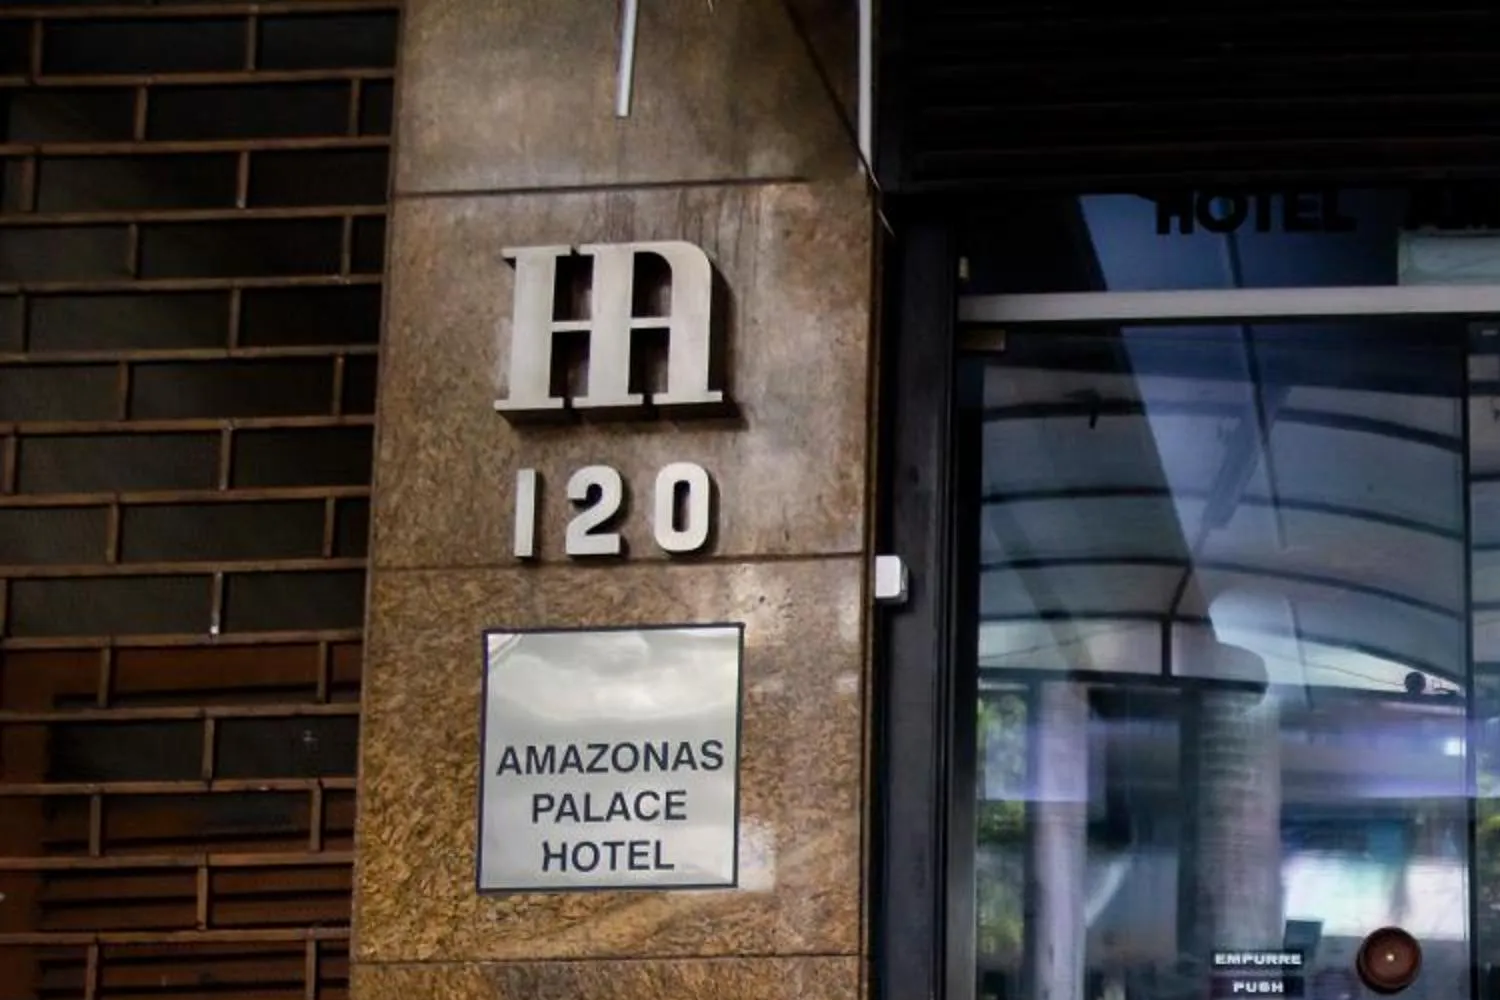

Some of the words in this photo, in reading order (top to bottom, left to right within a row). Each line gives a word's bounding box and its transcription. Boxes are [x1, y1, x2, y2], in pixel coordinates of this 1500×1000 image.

[1157, 187, 1357, 234] HOTEL
[514, 462, 711, 557] 120
[496, 739, 724, 777] AMAZONAS
[532, 789, 688, 824] PALACE
[541, 840, 675, 872] HOTEL
[1214, 952, 1302, 965] EMPURRE
[1233, 980, 1284, 993] PUSH
